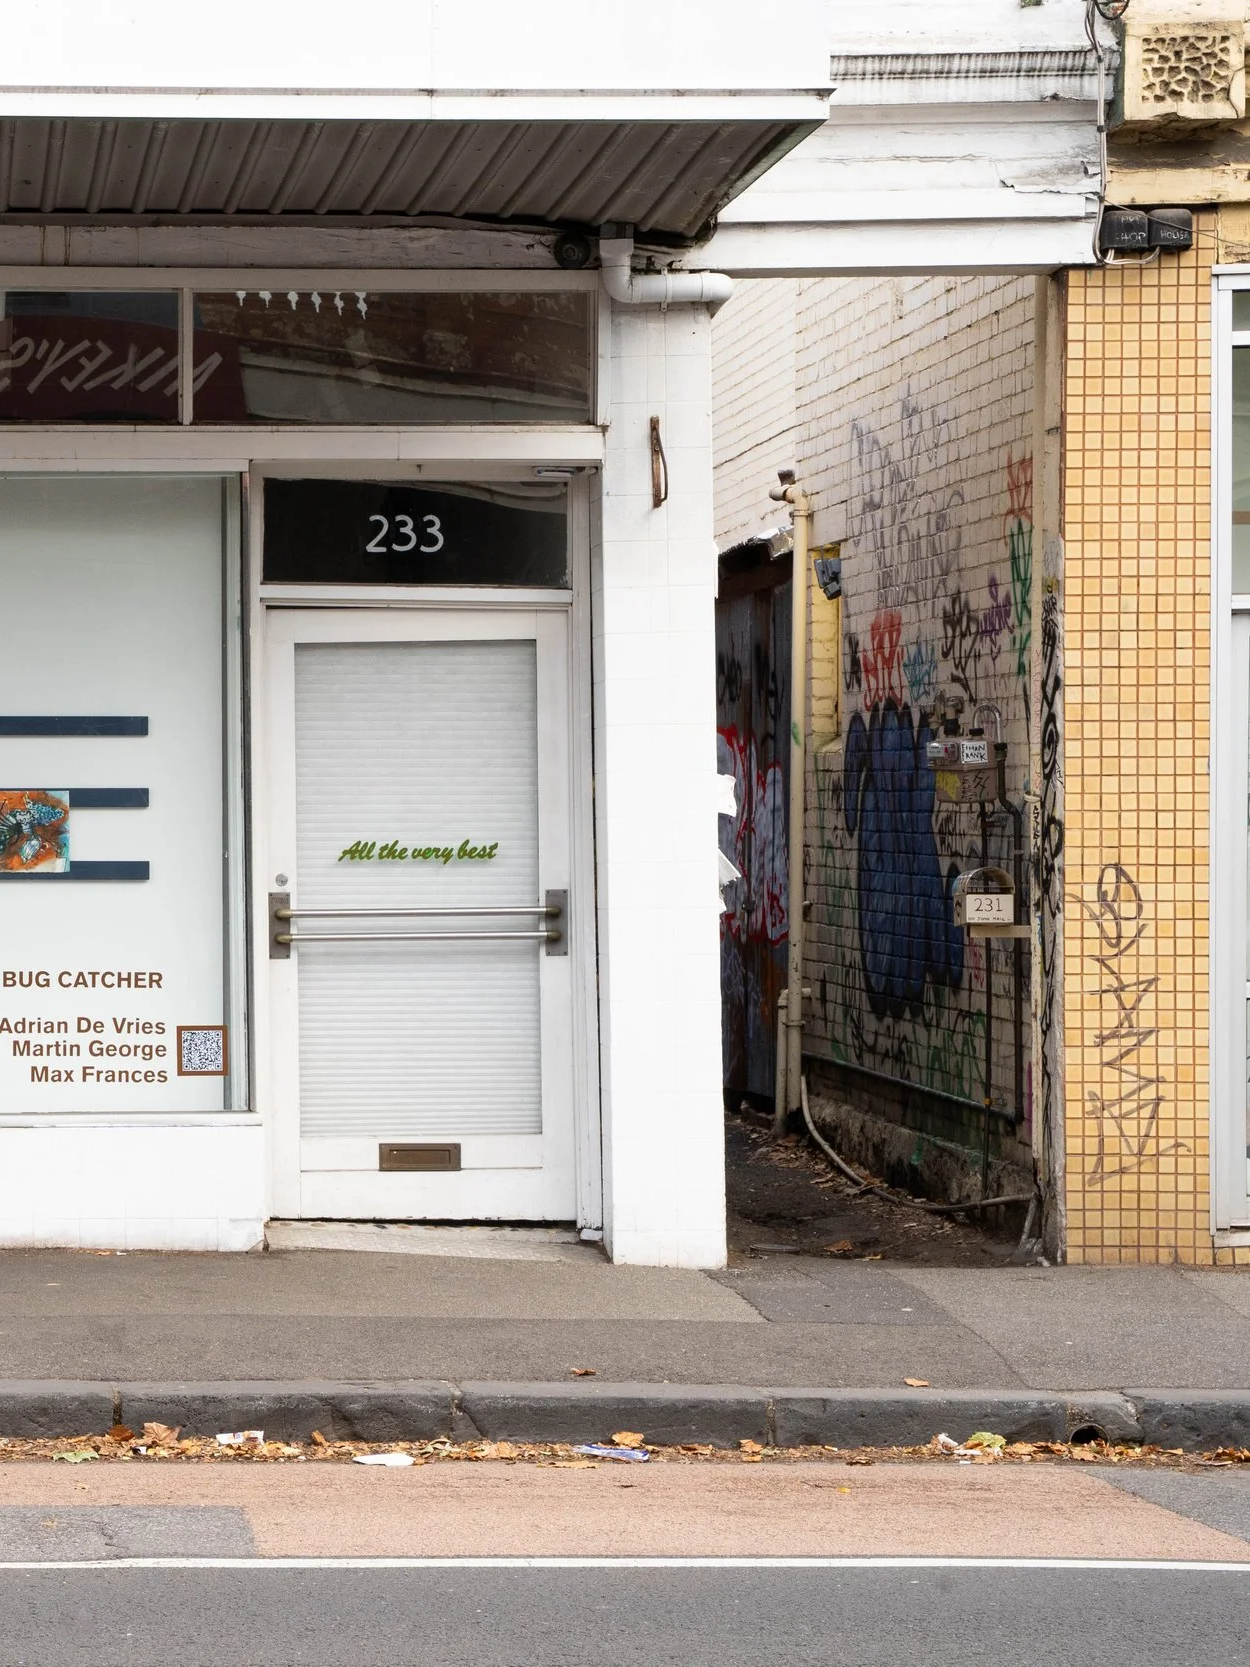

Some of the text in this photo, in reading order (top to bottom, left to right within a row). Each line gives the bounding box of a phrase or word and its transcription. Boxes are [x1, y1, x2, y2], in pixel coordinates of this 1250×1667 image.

[365, 513, 446, 553] 233
[338, 839, 498, 865] All the very best
[974, 897, 1003, 912] 231
[2, 971, 163, 989] BUG CATCHER
[76, 1017, 105, 1035] De
[112, 1017, 166, 1035] Vries
[12, 1040, 167, 1061] Martin George
[30, 1066, 168, 1083] Max Frances
